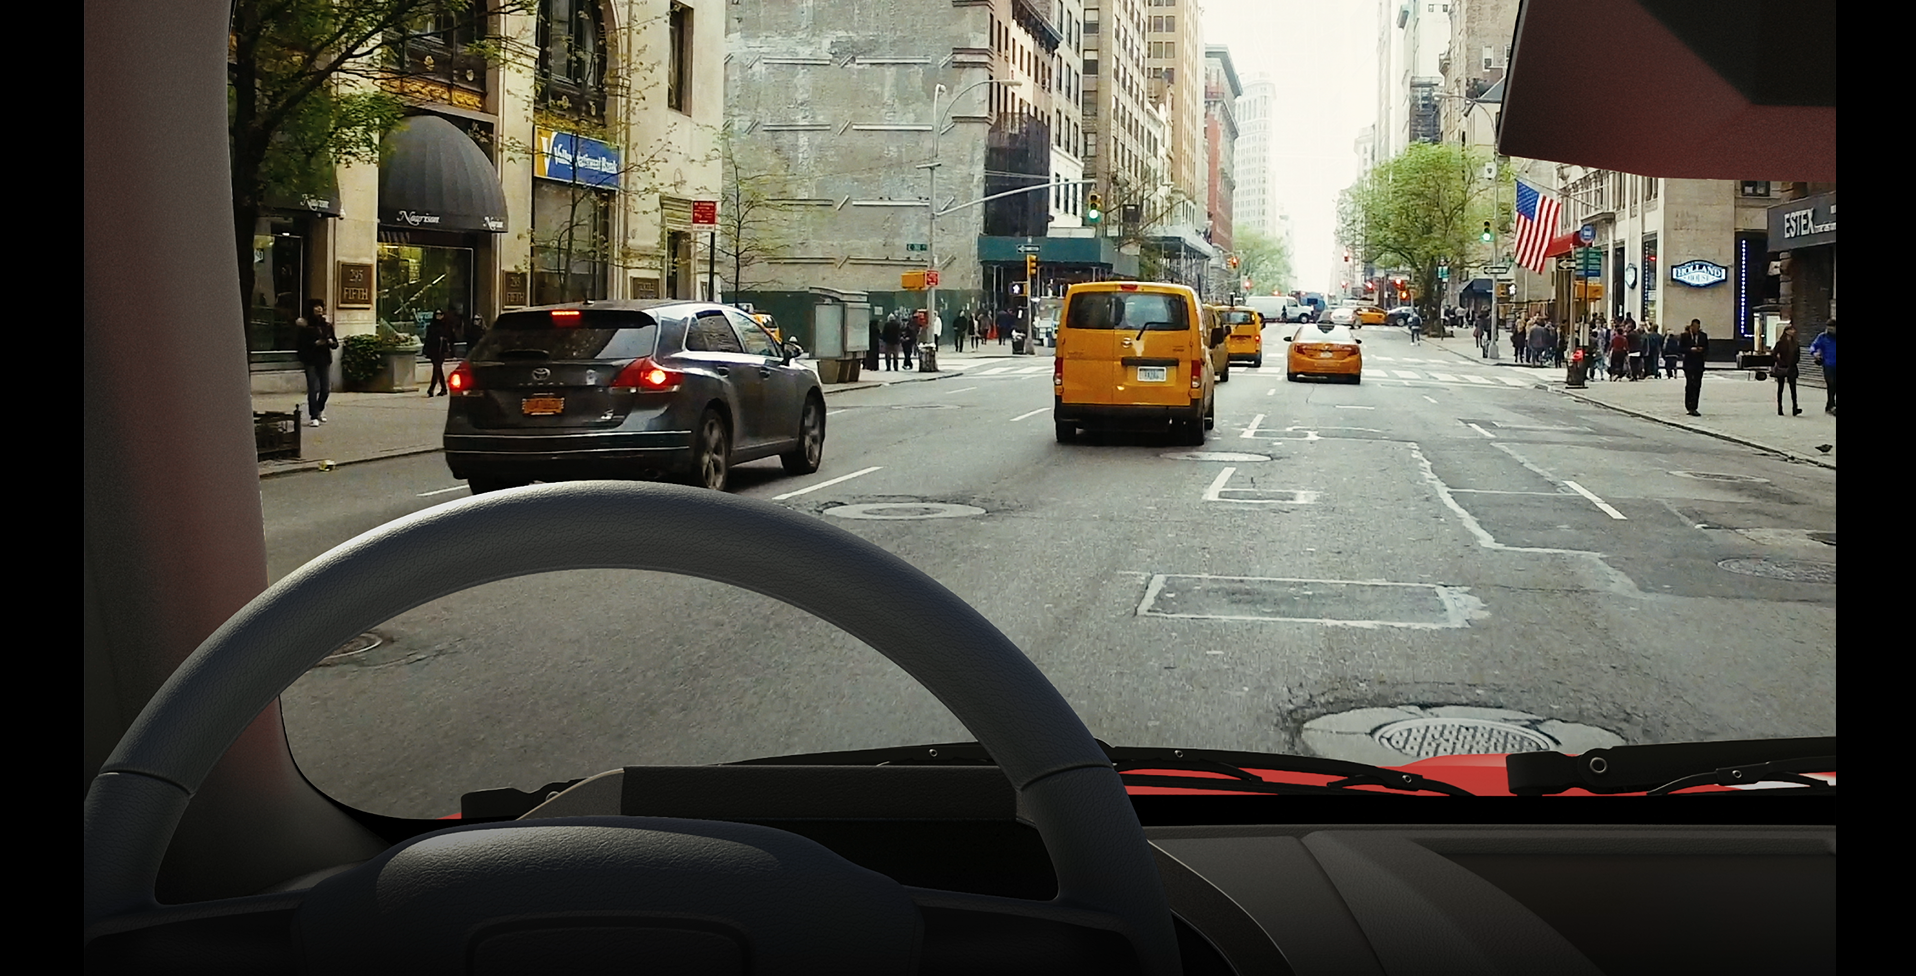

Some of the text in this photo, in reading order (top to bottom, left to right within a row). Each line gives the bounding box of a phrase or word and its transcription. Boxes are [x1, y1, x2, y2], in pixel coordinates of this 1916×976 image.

[601, 156, 618, 174] Bank
[1784, 207, 1815, 239] ESTEX
[1675, 264, 1721, 278] HOLLAND
[343, 287, 369, 300] FIFTH
